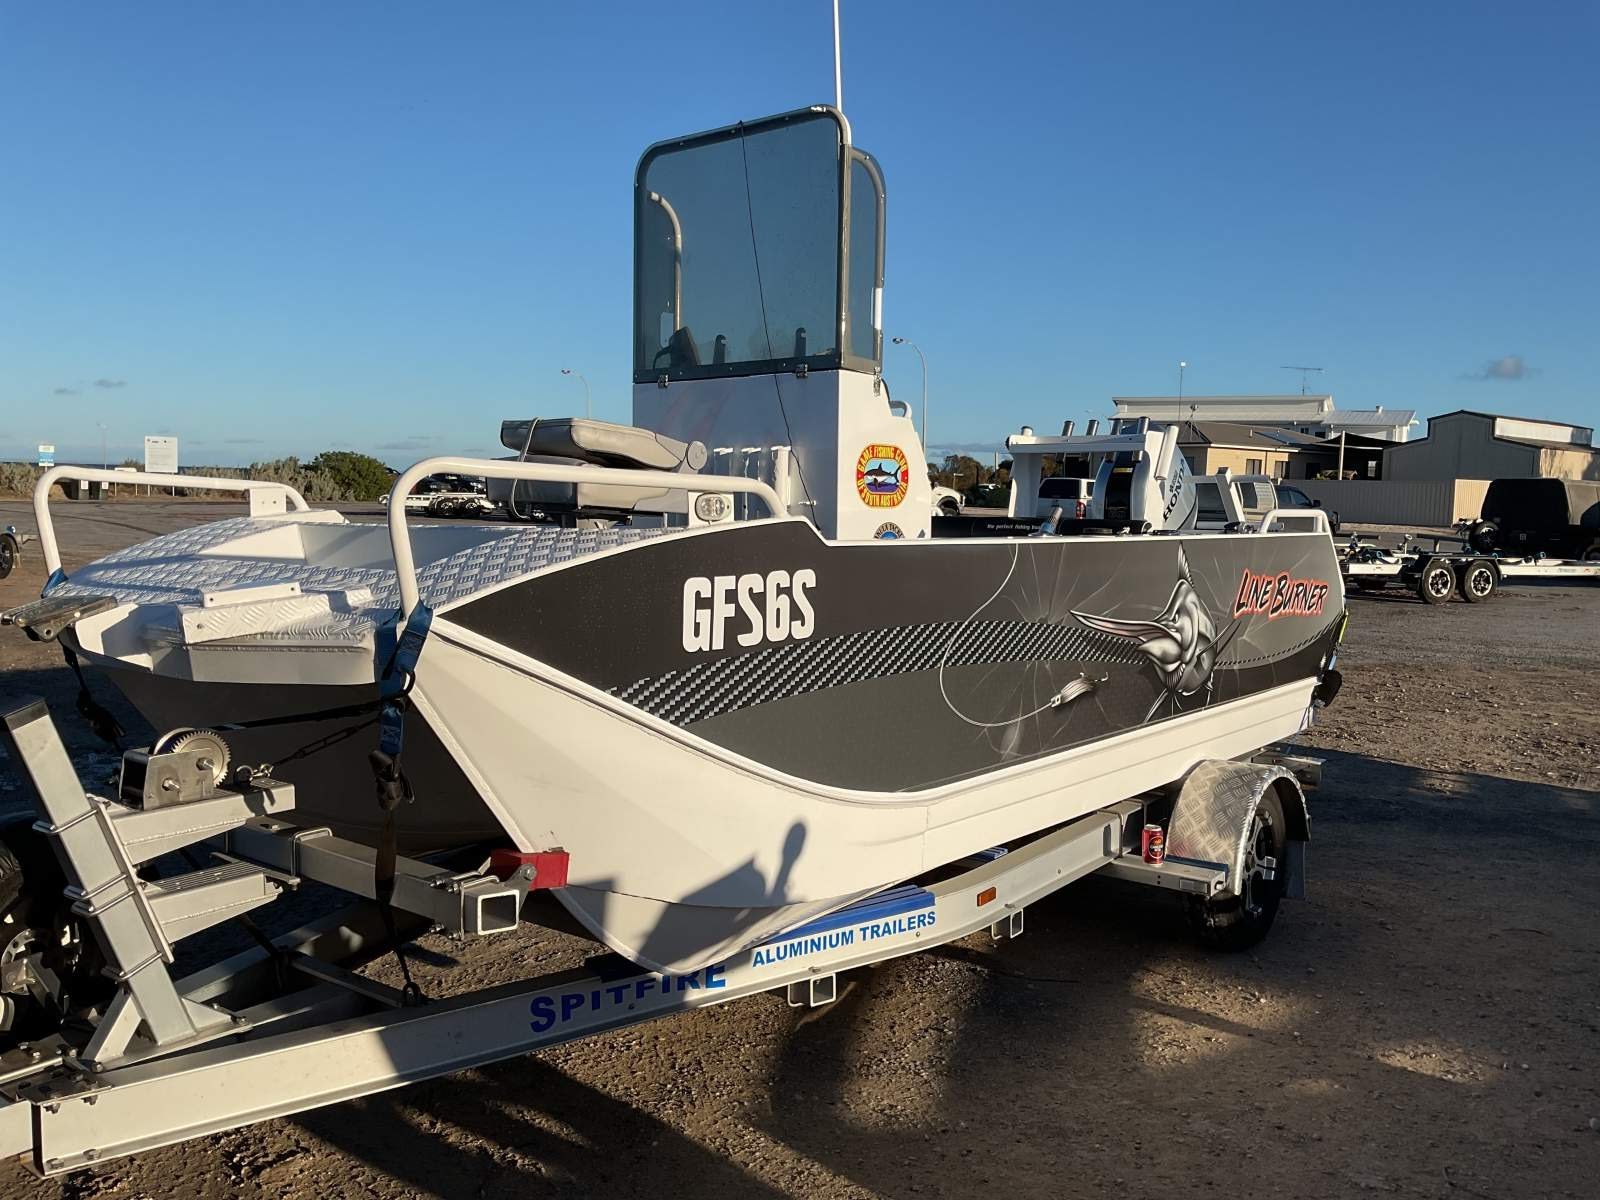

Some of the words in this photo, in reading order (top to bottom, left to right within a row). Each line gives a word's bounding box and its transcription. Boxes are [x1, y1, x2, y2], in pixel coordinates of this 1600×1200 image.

[857, 447, 873, 472] GAME
[873, 446, 895, 459] FISHING
[894, 448, 908, 472] CLUB
[1163, 458, 1187, 522] HONDA
[861, 487, 880, 507] SOUTH
[879, 481, 908, 507] AUSTRALIA
[995, 523, 1014, 532] perfect
[683, 568, 817, 653] GFS6S
[752, 930, 854, 967] ALUMINIUM
[859, 901, 936, 941] TRAILERS
[529, 963, 727, 1033] SPITFIRE
